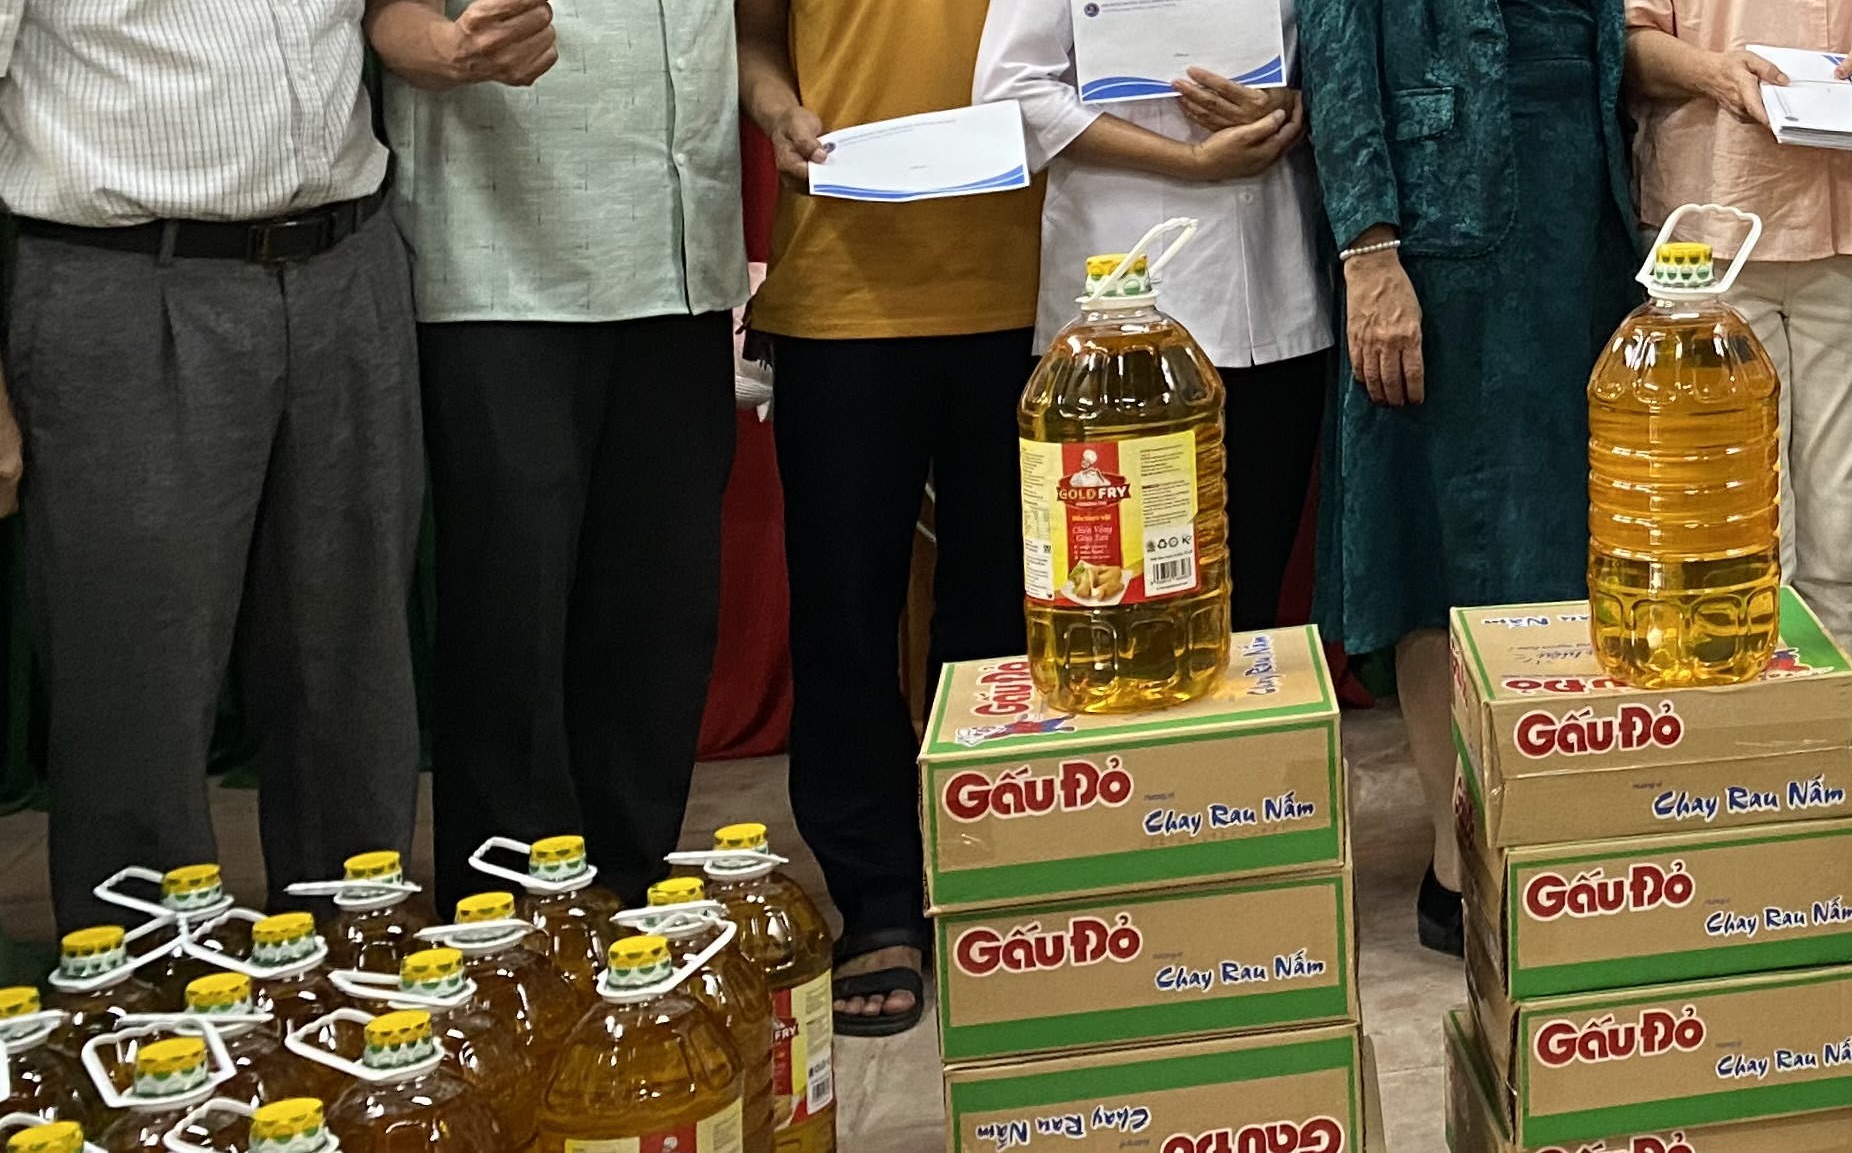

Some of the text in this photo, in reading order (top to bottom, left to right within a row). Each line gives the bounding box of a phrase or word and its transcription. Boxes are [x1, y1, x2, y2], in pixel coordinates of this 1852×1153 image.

[1059, 486, 1127, 500] GOLD FRY
[1517, 701, 1682, 757] Gấu Đỏ
[945, 757, 1132, 820] Gấu Đỏ
[1653, 773, 1845, 821] Chay Rau Nấm
[1145, 792, 1315, 836] Chay Rau Nấm
[1527, 861, 1693, 919] Gấu Đỏ
[957, 914, 1141, 976] Gấu Đỏ
[1706, 912, 1758, 935] Chay
[1765, 907, 1806, 928] Rau
[1156, 950, 1325, 993] Chay Rau Nấm
[1538, 1007, 1705, 1066] Gấu Đỏ
[1716, 1055, 1769, 1078] Chay
[1776, 1049, 1817, 1069] Rau
[975, 1104, 1151, 1153] Chay Rau Nấm
